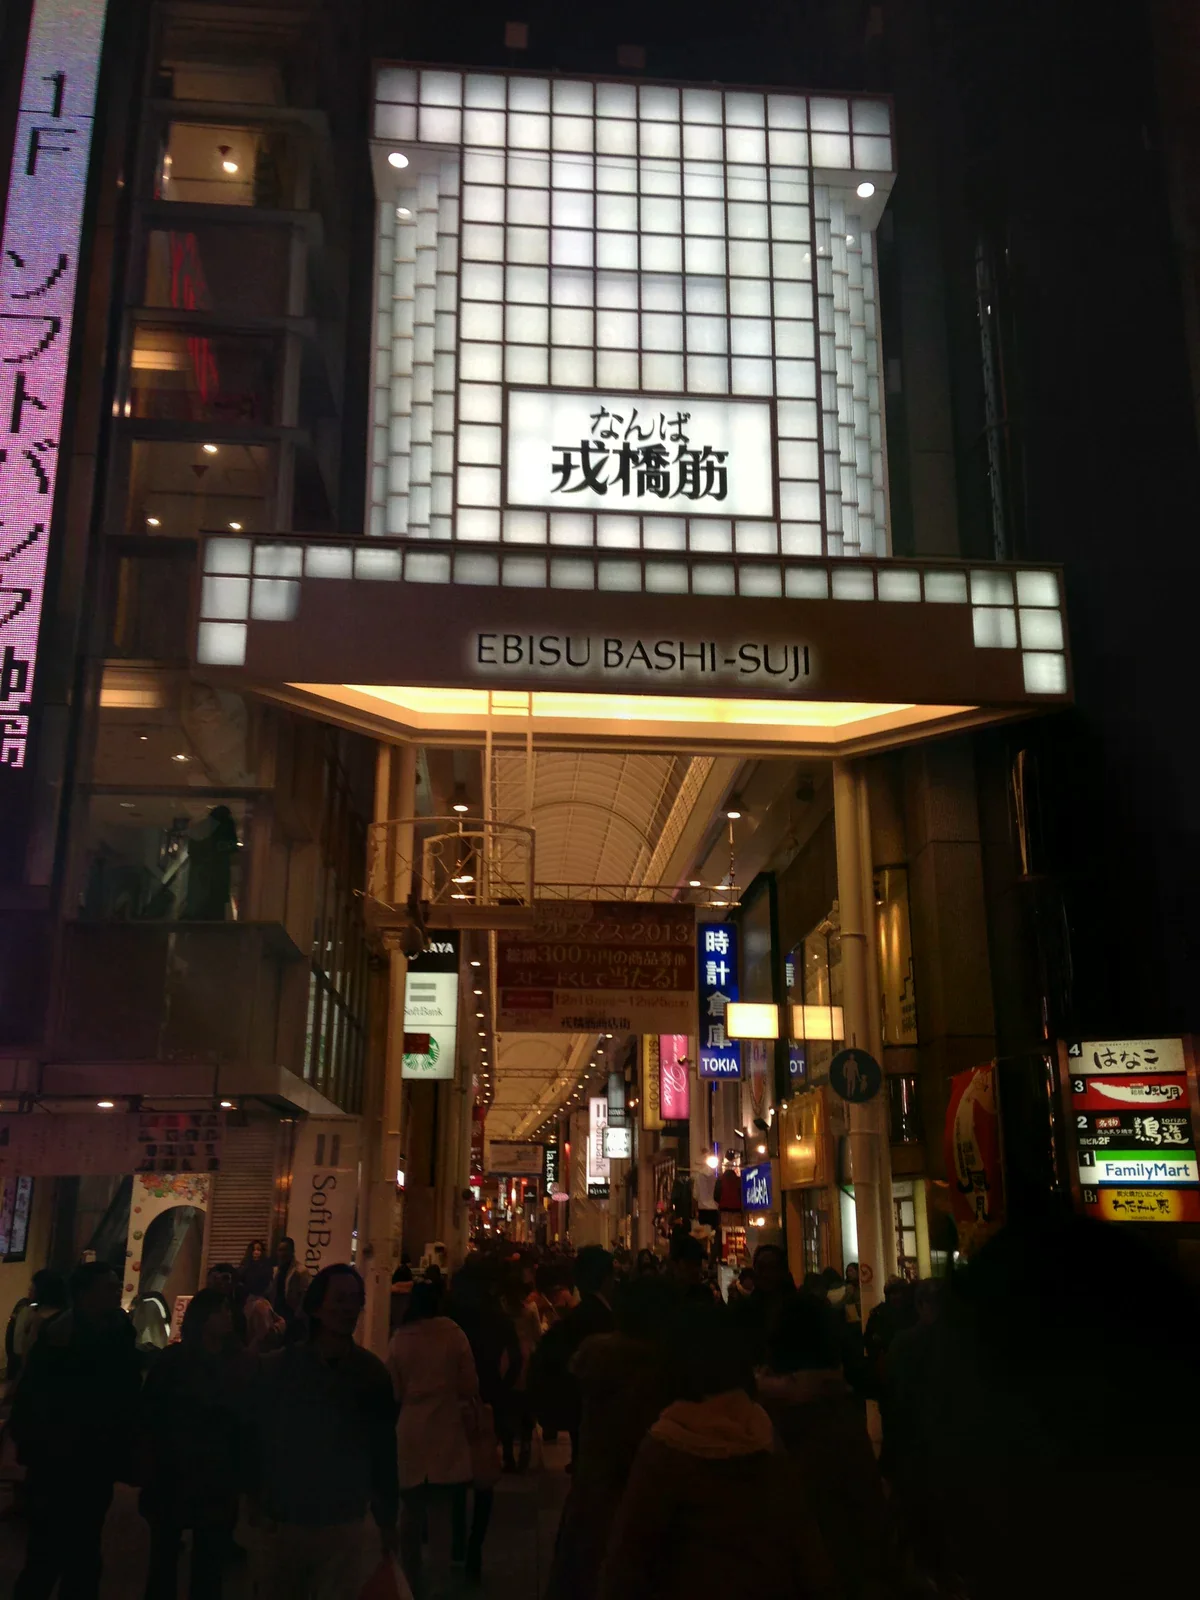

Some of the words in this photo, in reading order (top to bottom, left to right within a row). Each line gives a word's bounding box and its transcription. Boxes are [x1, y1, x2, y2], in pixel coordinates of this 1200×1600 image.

[589, 405, 691, 444] なんば
[550, 440, 729, 501] 戎橋筋
[477, 633, 591, 667] EBISU
[631, 922, 689, 943] 2013
[704, 929, 733, 1050] 時計倉庫
[1069, 1043, 1081, 1056] 4
[1093, 1047, 1160, 1070] はなこ
[702, 1057, 739, 1073] TOKIA
[1074, 1080, 1084, 1093] 3
[1077, 1115, 1088, 1129] 2
[1083, 1153, 1091, 1166] 1
[1106, 1162, 1191, 1180] FamilyMart
[304, 1173, 337, 1278] SoftBan
